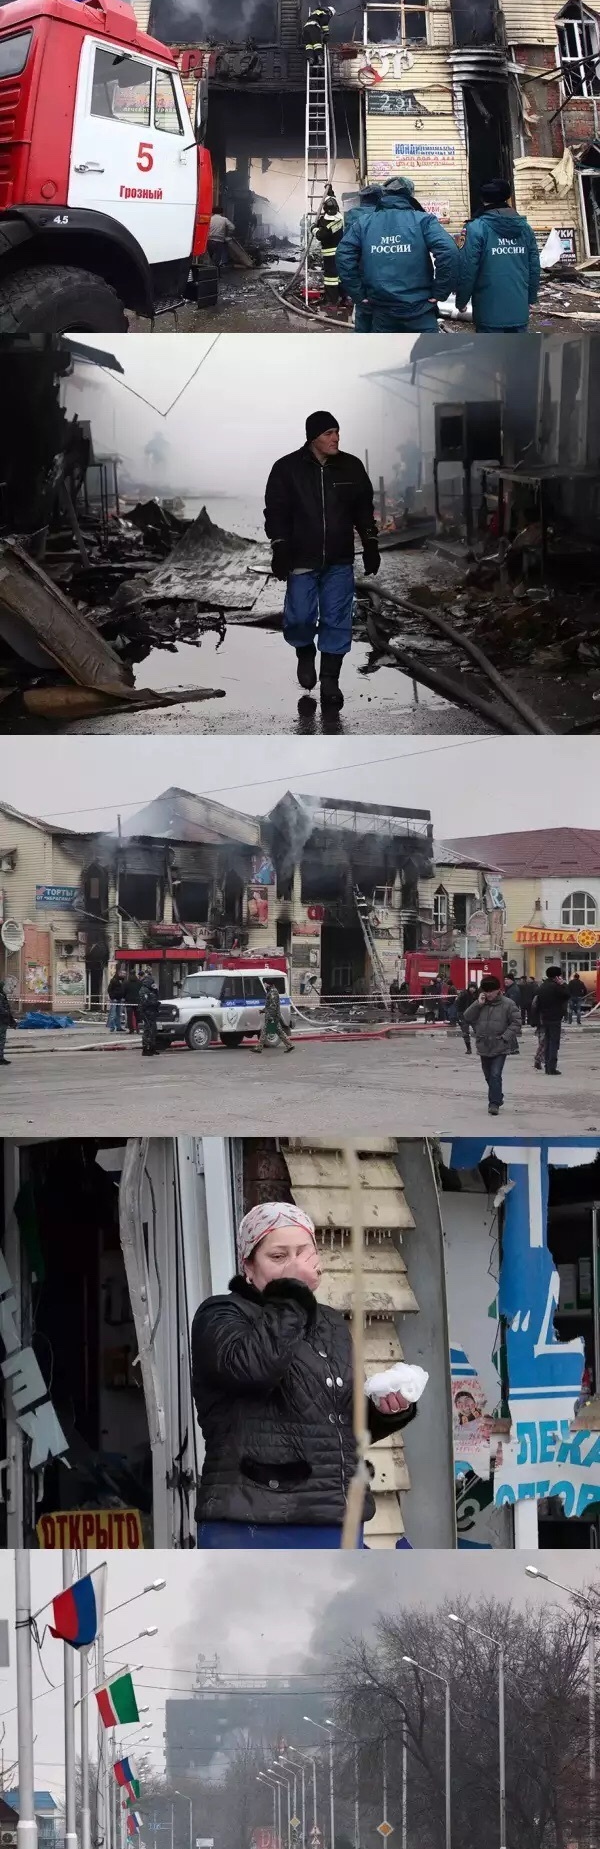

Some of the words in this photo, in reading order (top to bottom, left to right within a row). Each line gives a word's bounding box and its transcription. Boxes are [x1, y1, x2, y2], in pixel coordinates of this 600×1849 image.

[136, 141, 154, 172] 5
[119, 185, 163, 200] Грозный
[380, 235, 402, 245] МЧС
[498, 238, 517, 246] МЧС
[370, 244, 412, 254] РОССИИ
[491, 246, 526, 256] РОССИИ
[46, 888, 74, 897] ТОРТЫ
[516, 931, 576, 943] ПИЦЦА
[41, 1512, 140, 1549] ОТКРЫТО
